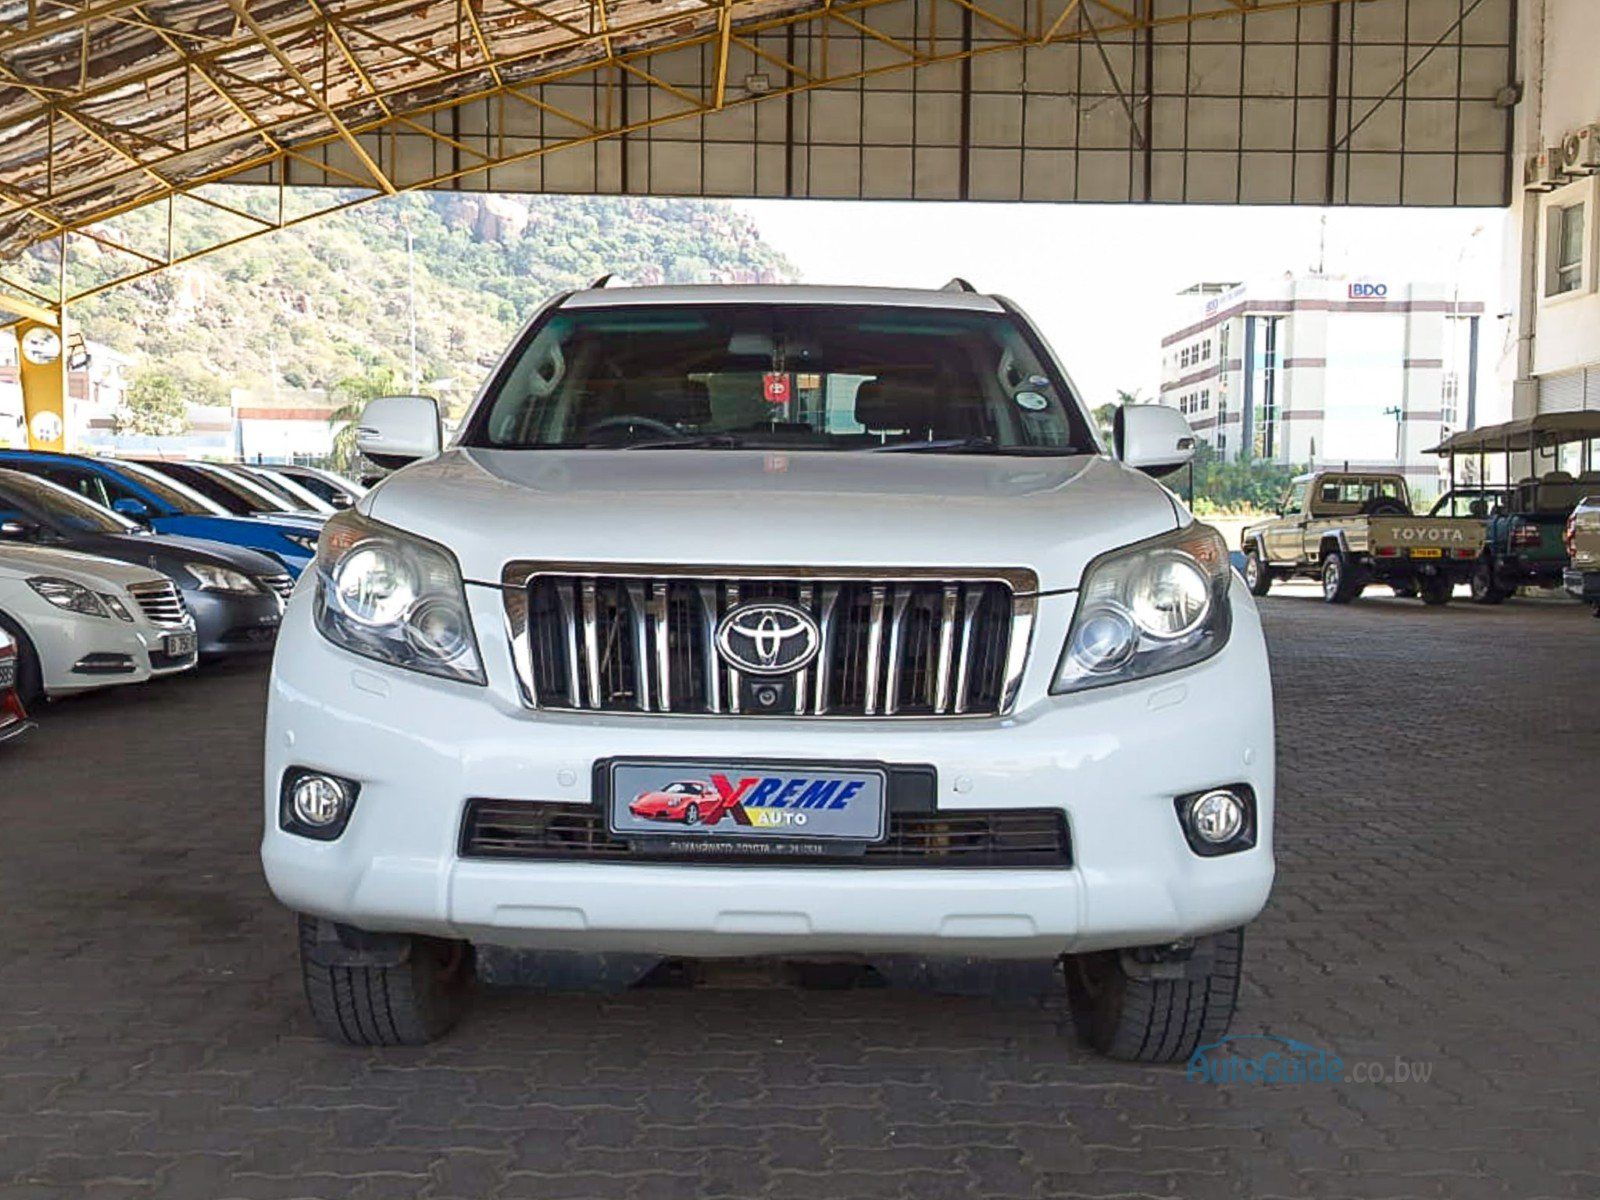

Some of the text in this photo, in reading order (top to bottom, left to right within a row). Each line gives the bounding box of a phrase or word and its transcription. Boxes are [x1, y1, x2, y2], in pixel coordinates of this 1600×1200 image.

[1353, 283, 1387, 296] BDO
[1391, 528, 1463, 541] TOYOTA
[702, 773, 866, 826] XREME
[757, 812, 808, 826] AUTO
